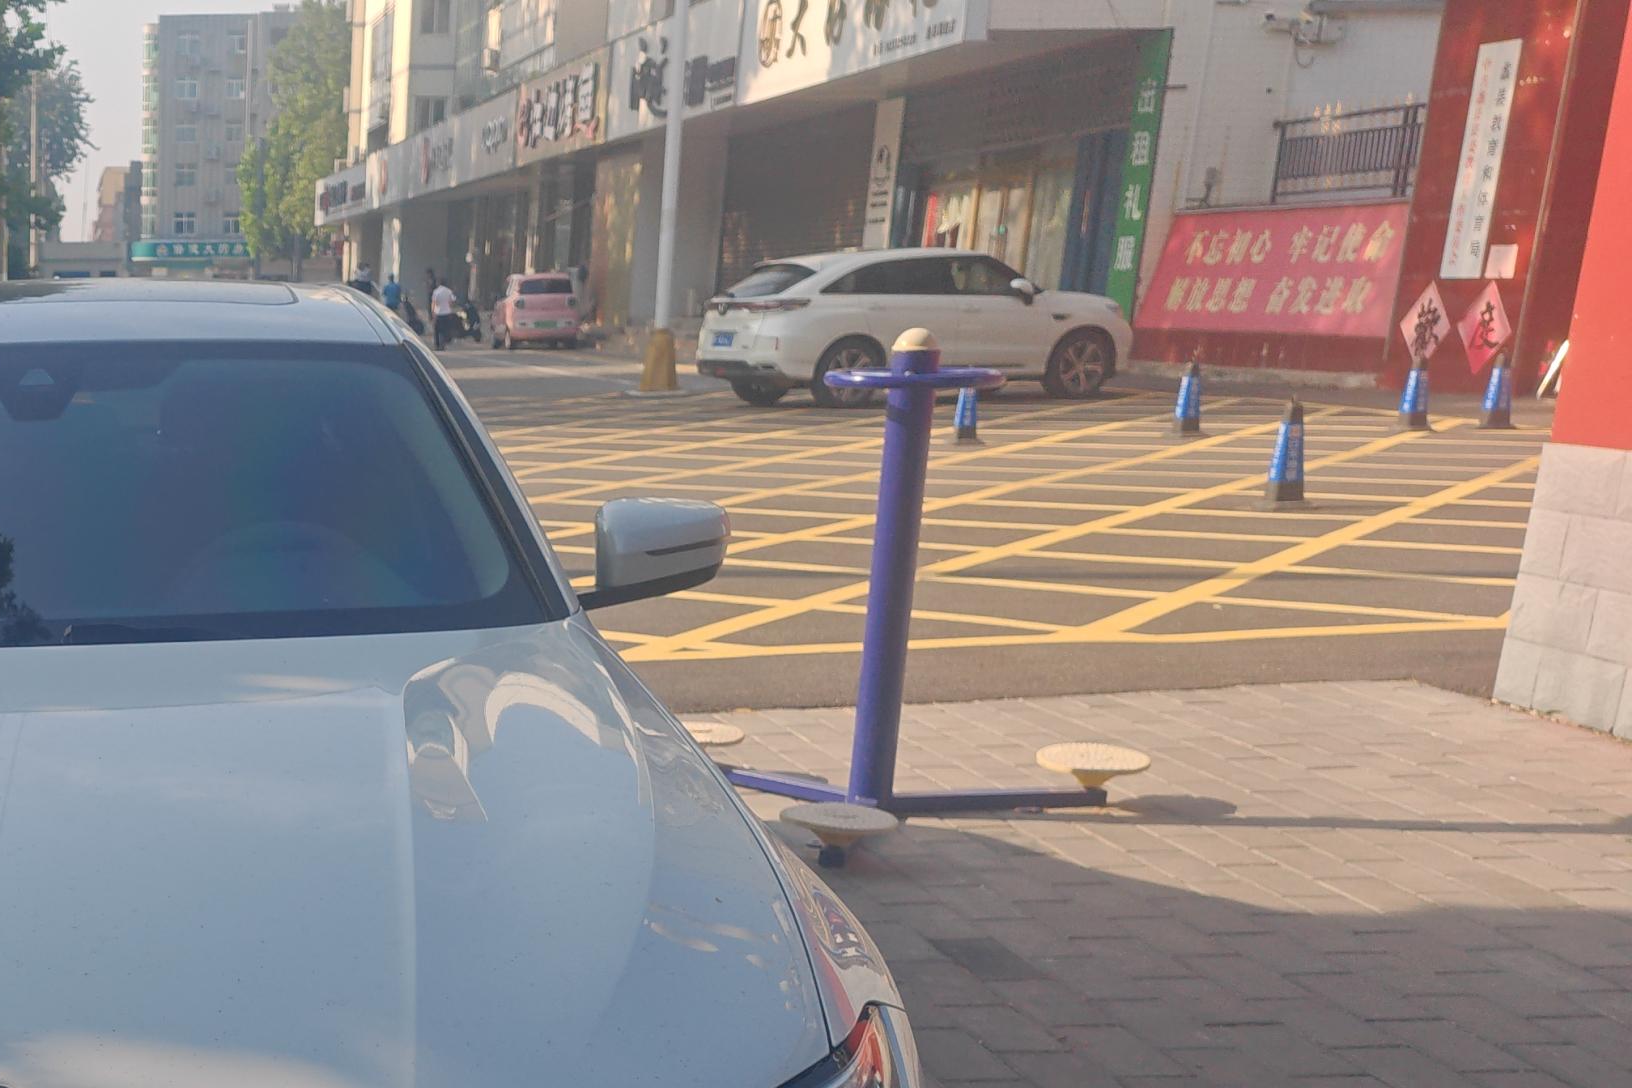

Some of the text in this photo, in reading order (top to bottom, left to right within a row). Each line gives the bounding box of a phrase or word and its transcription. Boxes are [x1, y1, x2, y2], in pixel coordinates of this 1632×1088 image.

[1186, 220, 1395, 265] 不忘初心 牢记使命
[1164, 276, 1258, 314] 解放思想
